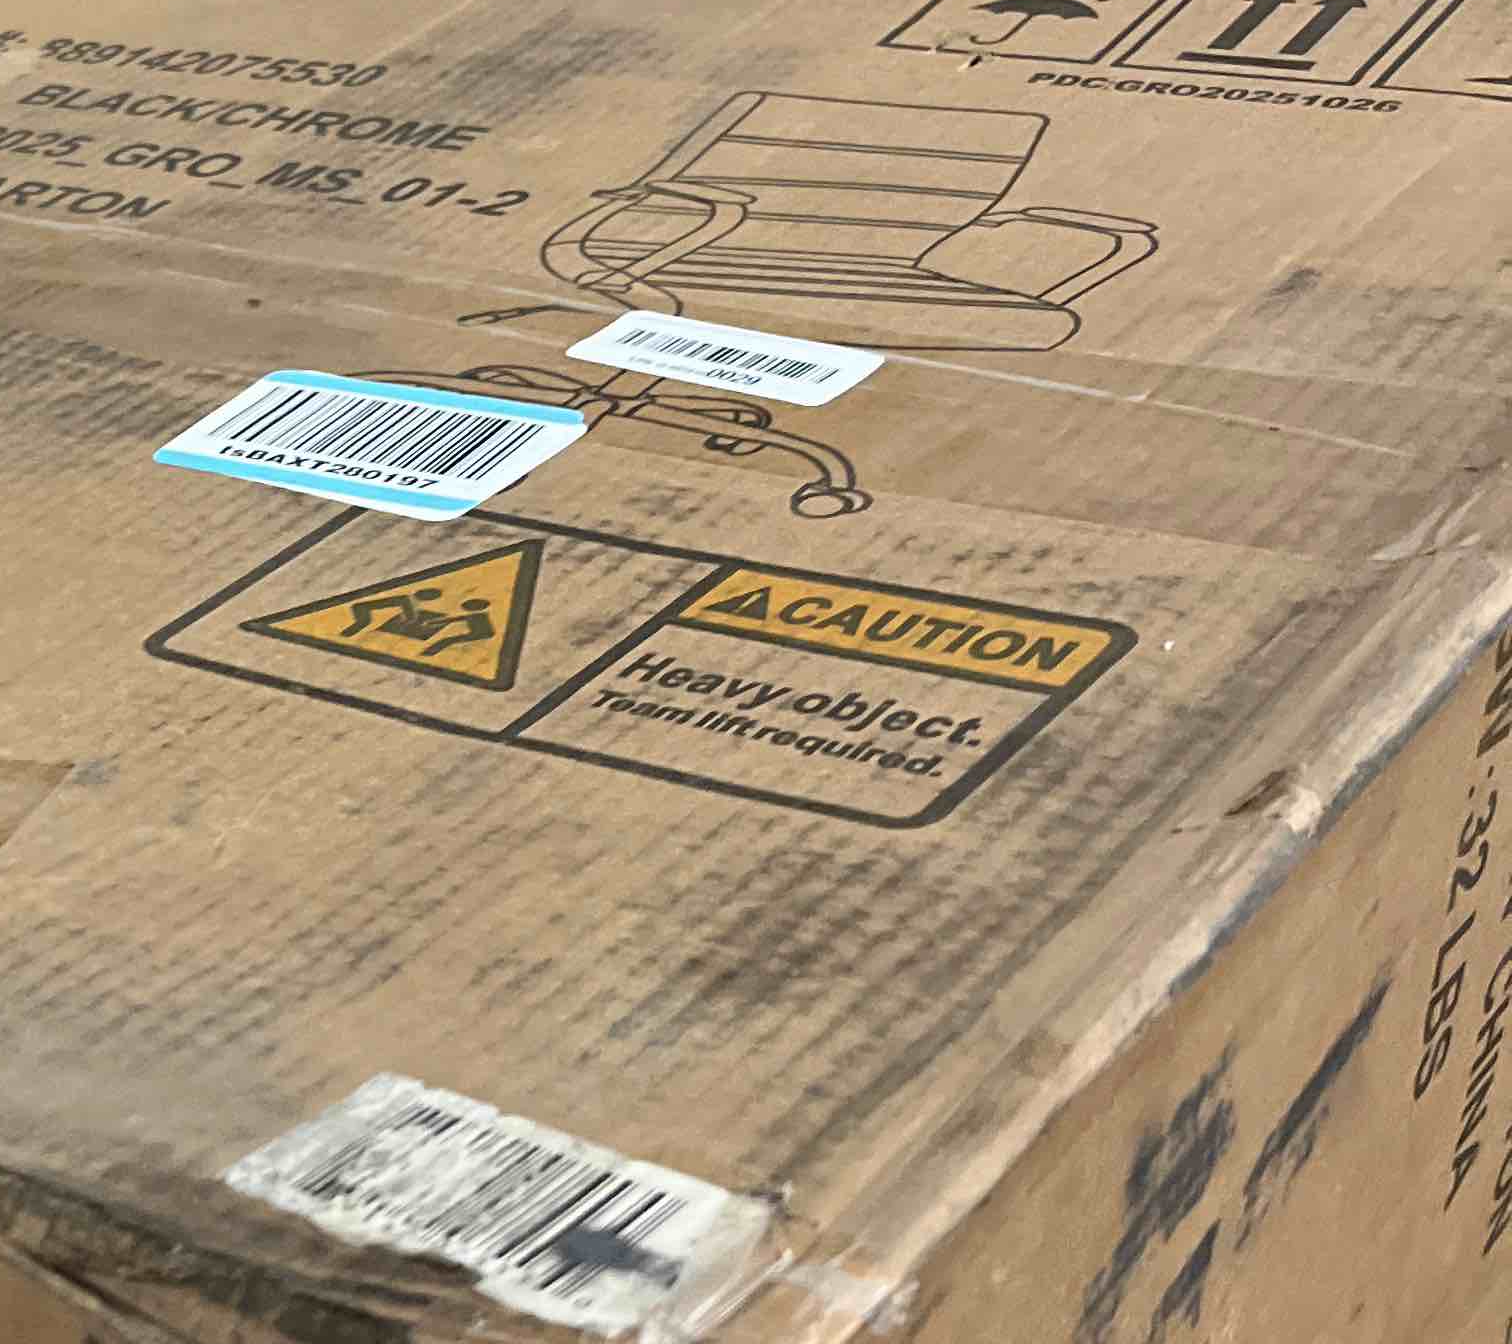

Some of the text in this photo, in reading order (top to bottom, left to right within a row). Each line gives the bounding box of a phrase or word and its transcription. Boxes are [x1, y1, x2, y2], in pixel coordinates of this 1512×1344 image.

[39, 37, 389, 90] 889142075530
[16, 83, 491, 153] BLACK/CHROME
[778, 595, 1081, 672] CAUTION
[617, 652, 792, 711] Heavy
[590, 689, 694, 727] Team
[694, 709, 751, 739] lift
[1413, 909, 1478, 1102] LBS
